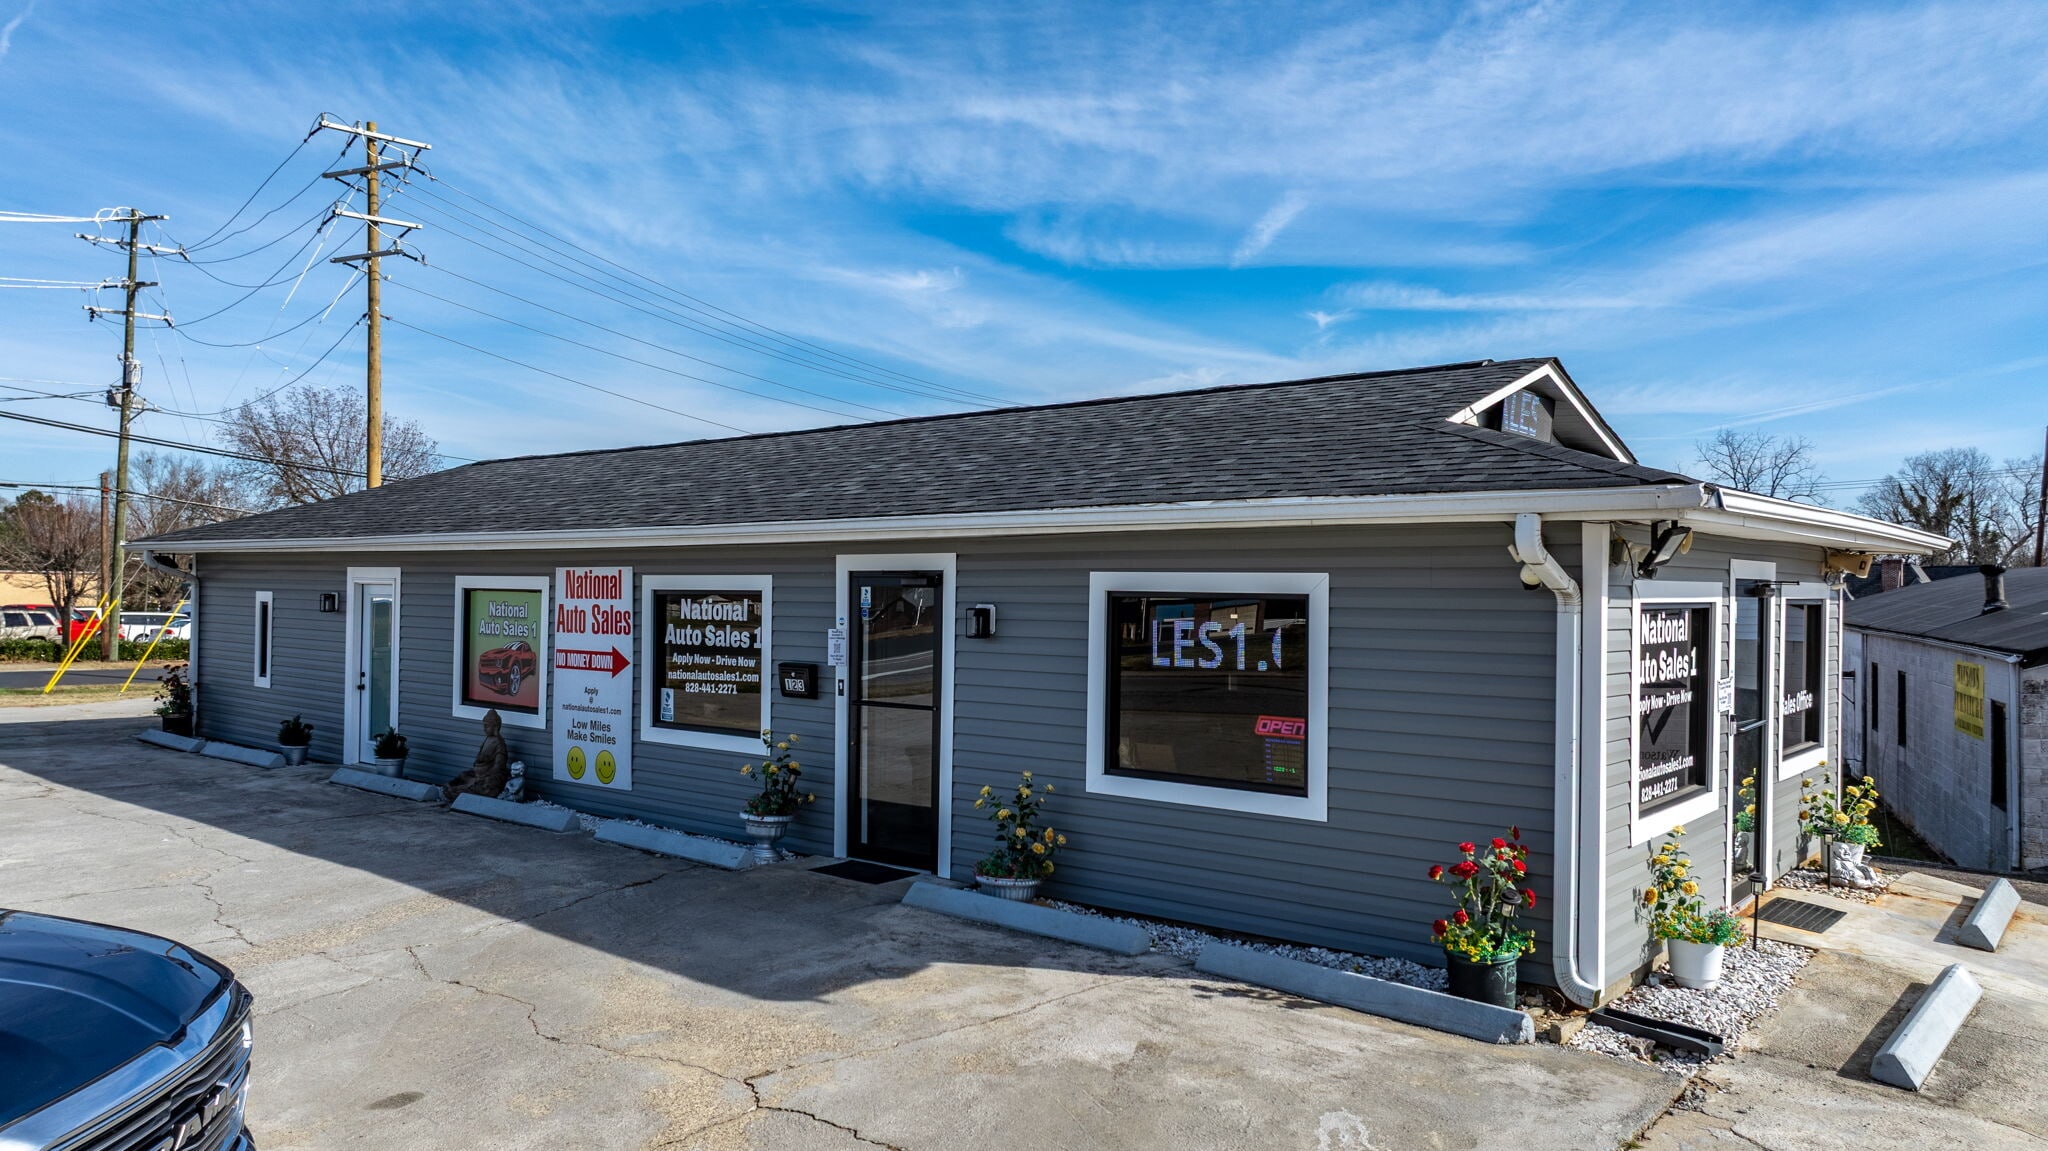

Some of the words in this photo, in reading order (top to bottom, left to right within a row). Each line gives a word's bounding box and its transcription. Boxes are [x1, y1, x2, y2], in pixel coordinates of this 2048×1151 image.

[565, 569, 622, 600] National
[489, 601, 528, 618] National
[680, 598, 748, 621] National
[557, 603, 586, 634] Auto
[591, 603, 632, 636] Sales
[1641, 610, 1689, 645] National
[479, 619, 501, 636] Auto
[503, 620, 529, 637] Sales
[531, 621, 537, 638] 1
[664, 623, 702, 646] Auto
[704, 624, 750, 648] Sales
[753, 626, 762, 648] 1
[556, 652, 566, 666] NO
[567, 653, 590, 668] MONEY
[591, 654, 613, 669] DOWN
[672, 652, 694, 666] Apply
[694, 653, 711, 664] Now
[716, 654, 737, 666] Drive
[738, 656, 756, 668] Now
[1659, 647, 1689, 681] Sales
[1690, 646, 1697, 677] 1
[667, 669, 760, 682] nationalautosales1.com
[583, 686, 599, 696] Apply
[685, 682, 738, 695] 828-441-2271
[785, 679, 804, 691] 123
[1651, 694, 1664, 710] Now
[1666, 690, 1680, 707] Drive
[1680, 689, 1693, 703] Now
[1796, 690, 1813, 712] Office
[562, 703, 622, 716] nationalautosales1.com
[572, 718, 588, 730] Low
[590, 720, 611, 733] Miles
[1258, 720, 1305, 735] OPEN
[567, 729, 587, 742] Make
[589, 732, 617, 745] Smiles
